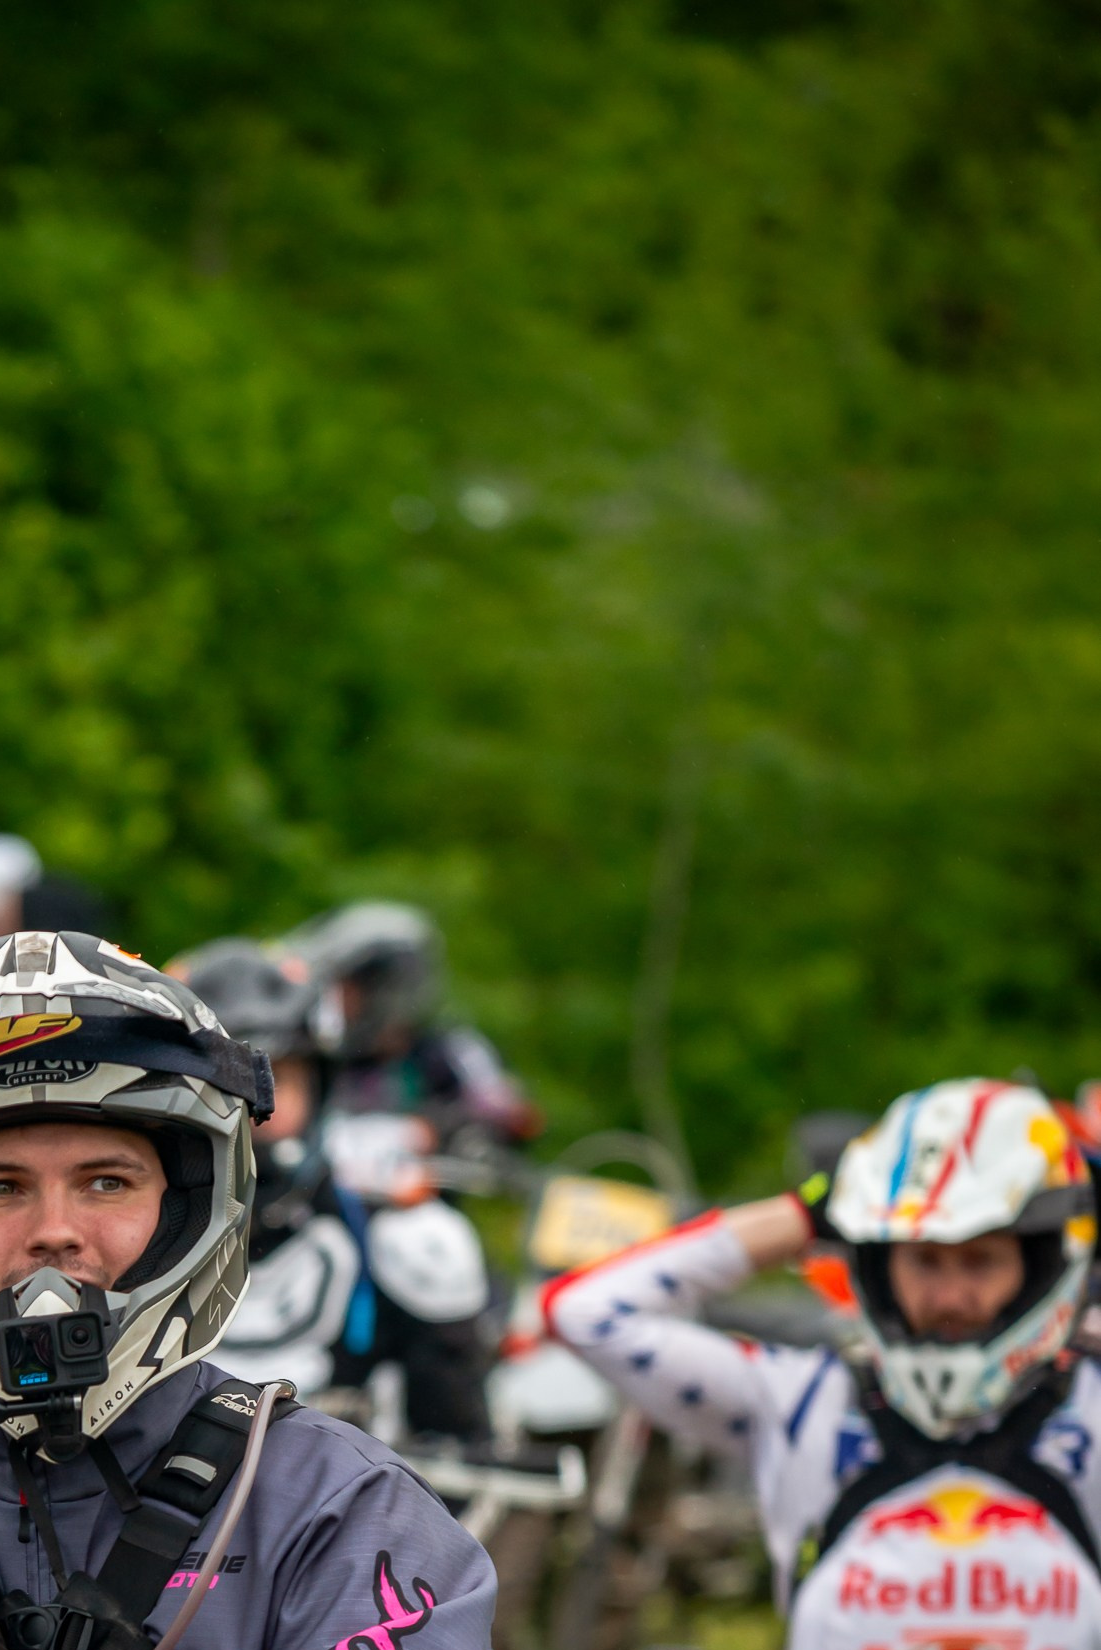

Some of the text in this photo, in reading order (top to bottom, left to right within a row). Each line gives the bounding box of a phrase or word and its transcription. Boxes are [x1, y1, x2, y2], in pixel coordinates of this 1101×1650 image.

[89, 1381, 134, 1428] AIROH
[838, 1561, 1079, 1619] Red Bull
